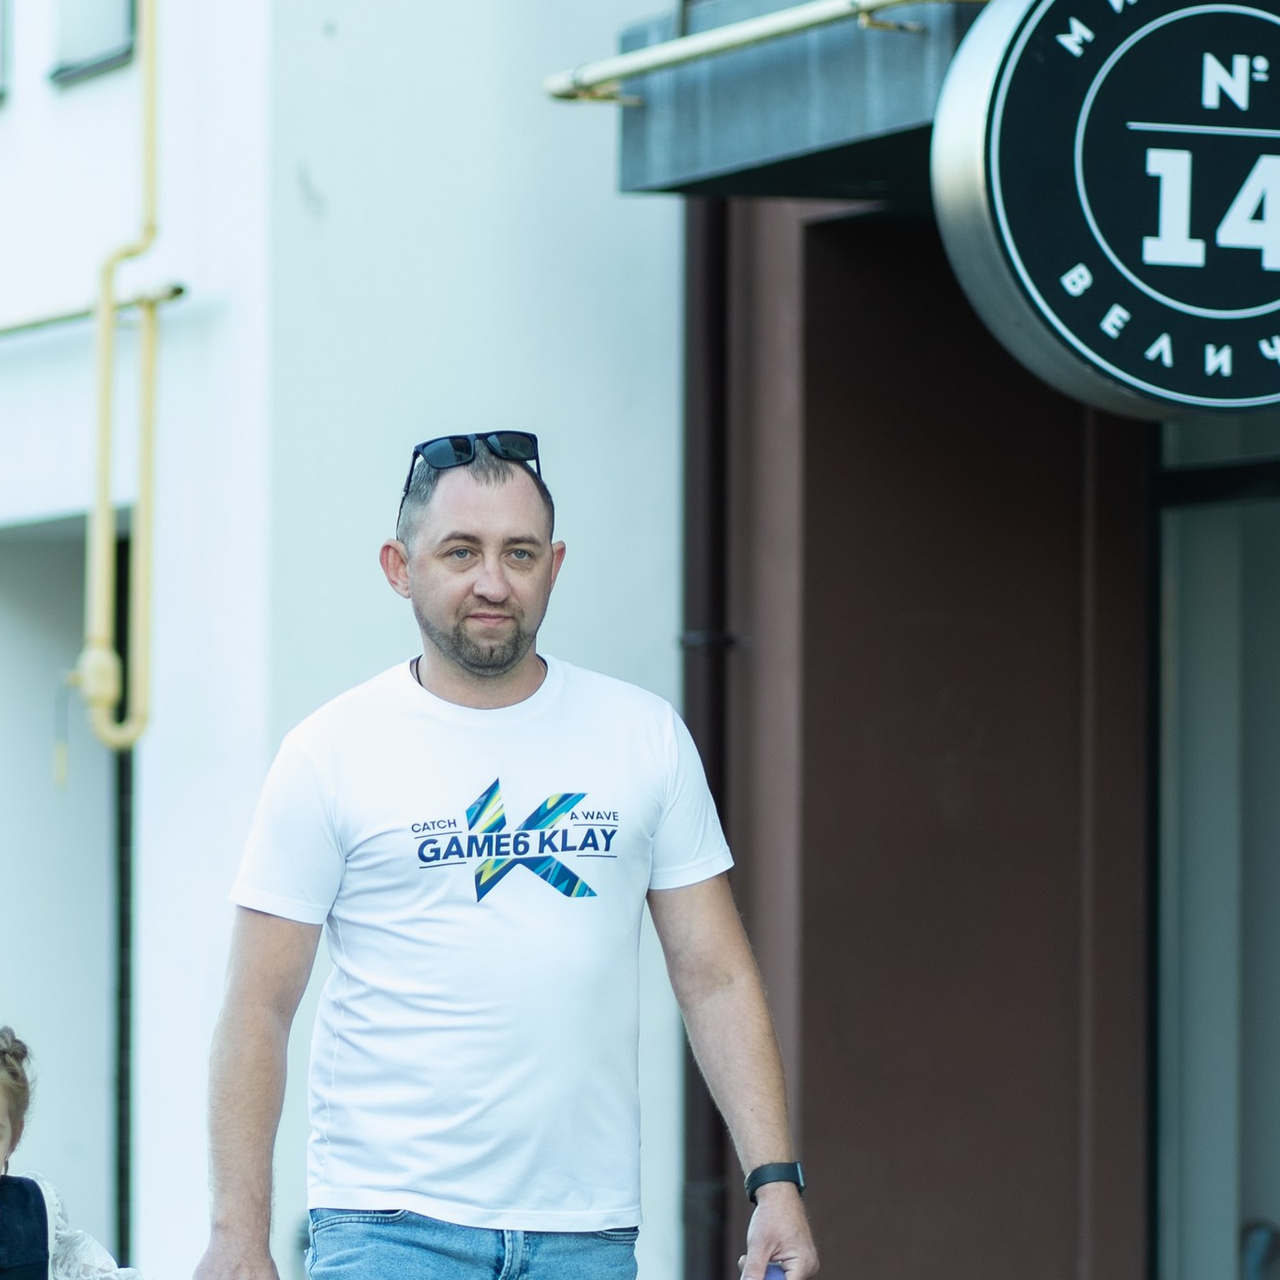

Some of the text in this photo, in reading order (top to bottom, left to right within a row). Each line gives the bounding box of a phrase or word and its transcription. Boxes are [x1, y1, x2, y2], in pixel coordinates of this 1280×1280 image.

[1142, 148, 1280, 271] 14
[411, 811, 619, 833] CATCH A WAVE
[417, 828, 618, 863] GAME6 KLAY
